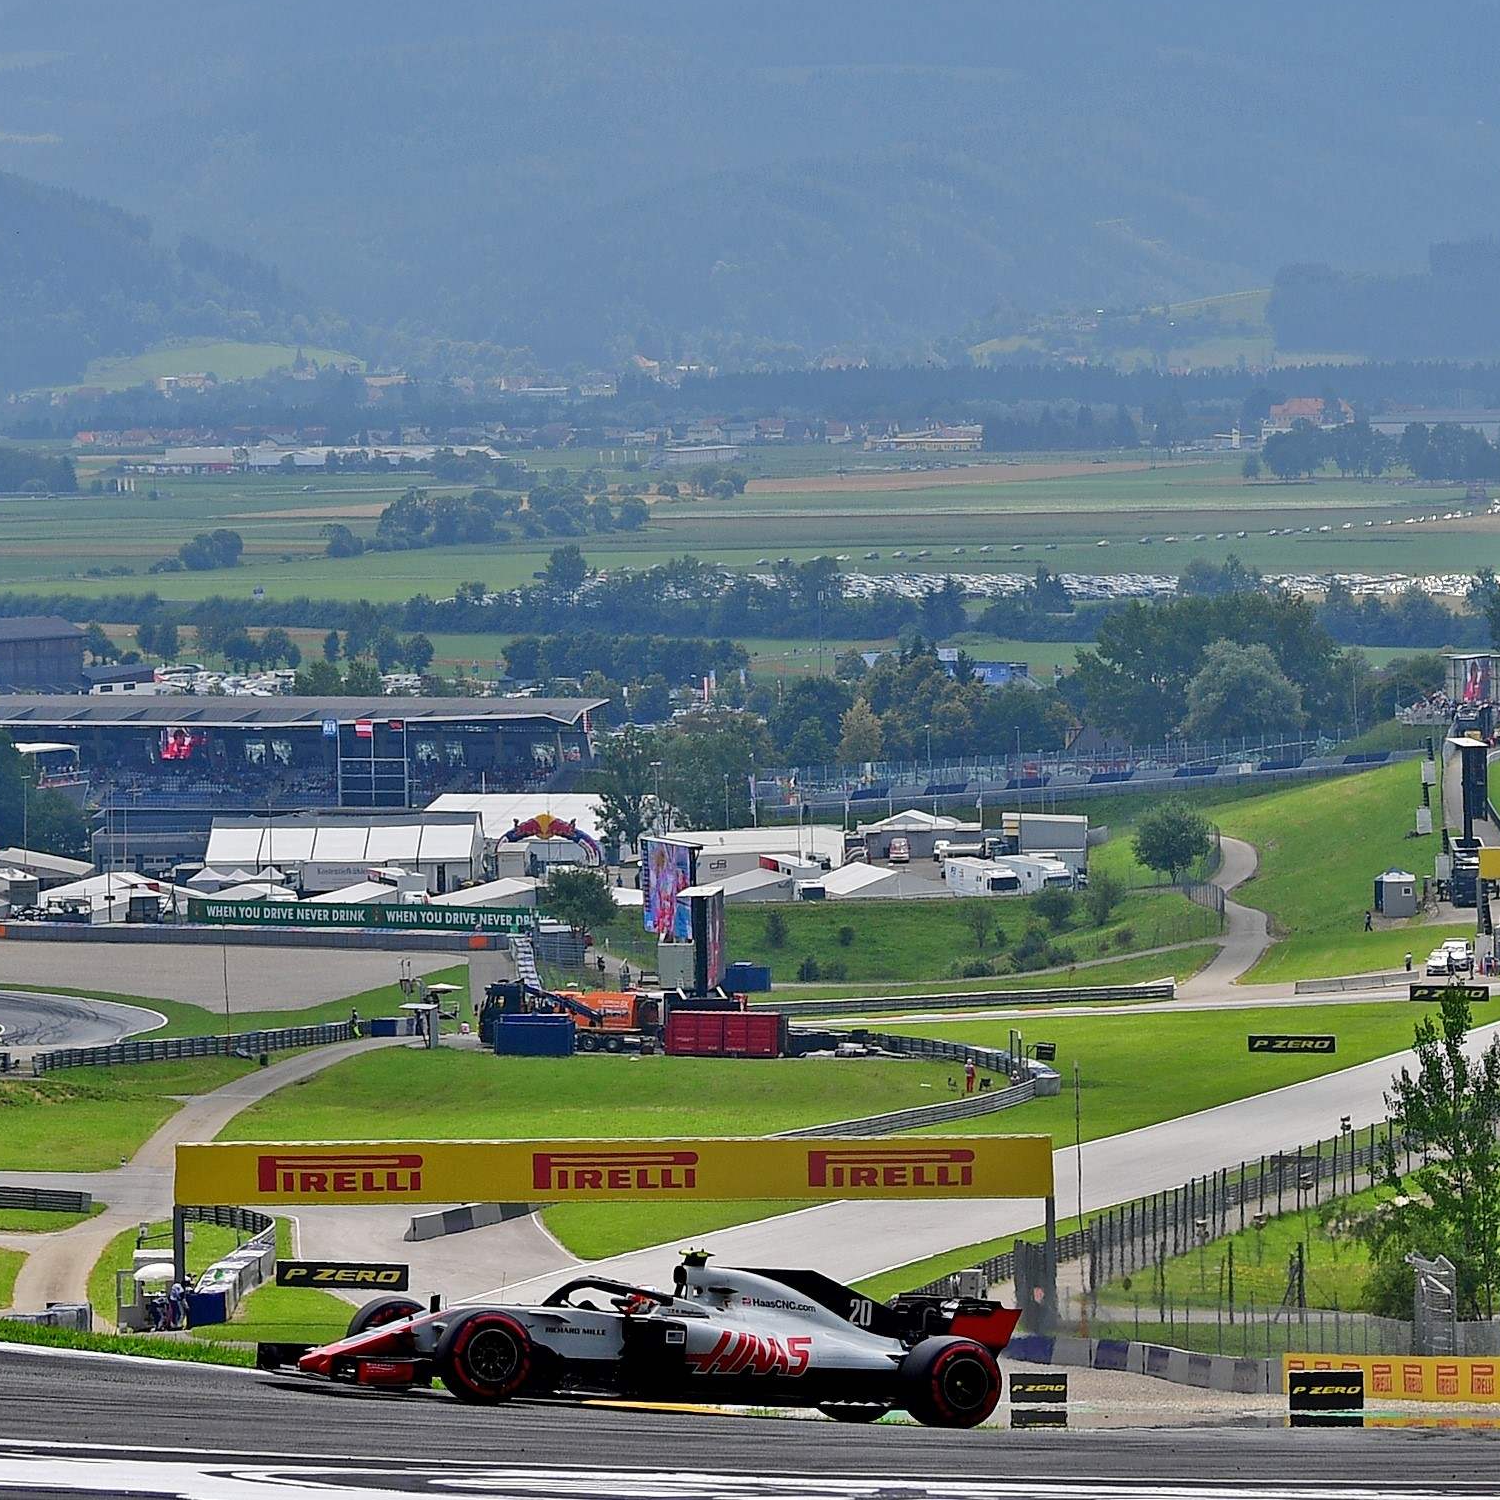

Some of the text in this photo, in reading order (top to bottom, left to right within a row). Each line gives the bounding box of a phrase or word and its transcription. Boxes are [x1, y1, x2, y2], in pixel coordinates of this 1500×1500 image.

[207, 906, 365, 922] WHEN YOU DRIVE NEVER DRINK
[386, 910, 418, 923] WHEN
[420, 911, 442, 924] YOU
[445, 912, 476, 925] DRIVE
[479, 914, 512, 926] NEVER
[1414, 989, 1430, 998] P
[1253, 1040, 1332, 1050] P ZERO
[258, 1155, 423, 1192] PIRELLI
[532, 1151, 699, 1190] PIRELLI
[808, 1149, 975, 1188] PIRELLI
[284, 1268, 401, 1283] P ZERO
[753, 1298, 816, 1313] HaasCNC.com
[849, 1298, 872, 1326] 20
[545, 1327, 606, 1336] RICHARD MILLE
[685, 1330, 812, 1377] HAAS
[1012, 1384, 1066, 1392] P ZERO
[1292, 1386, 1362, 1395] P ZERO
